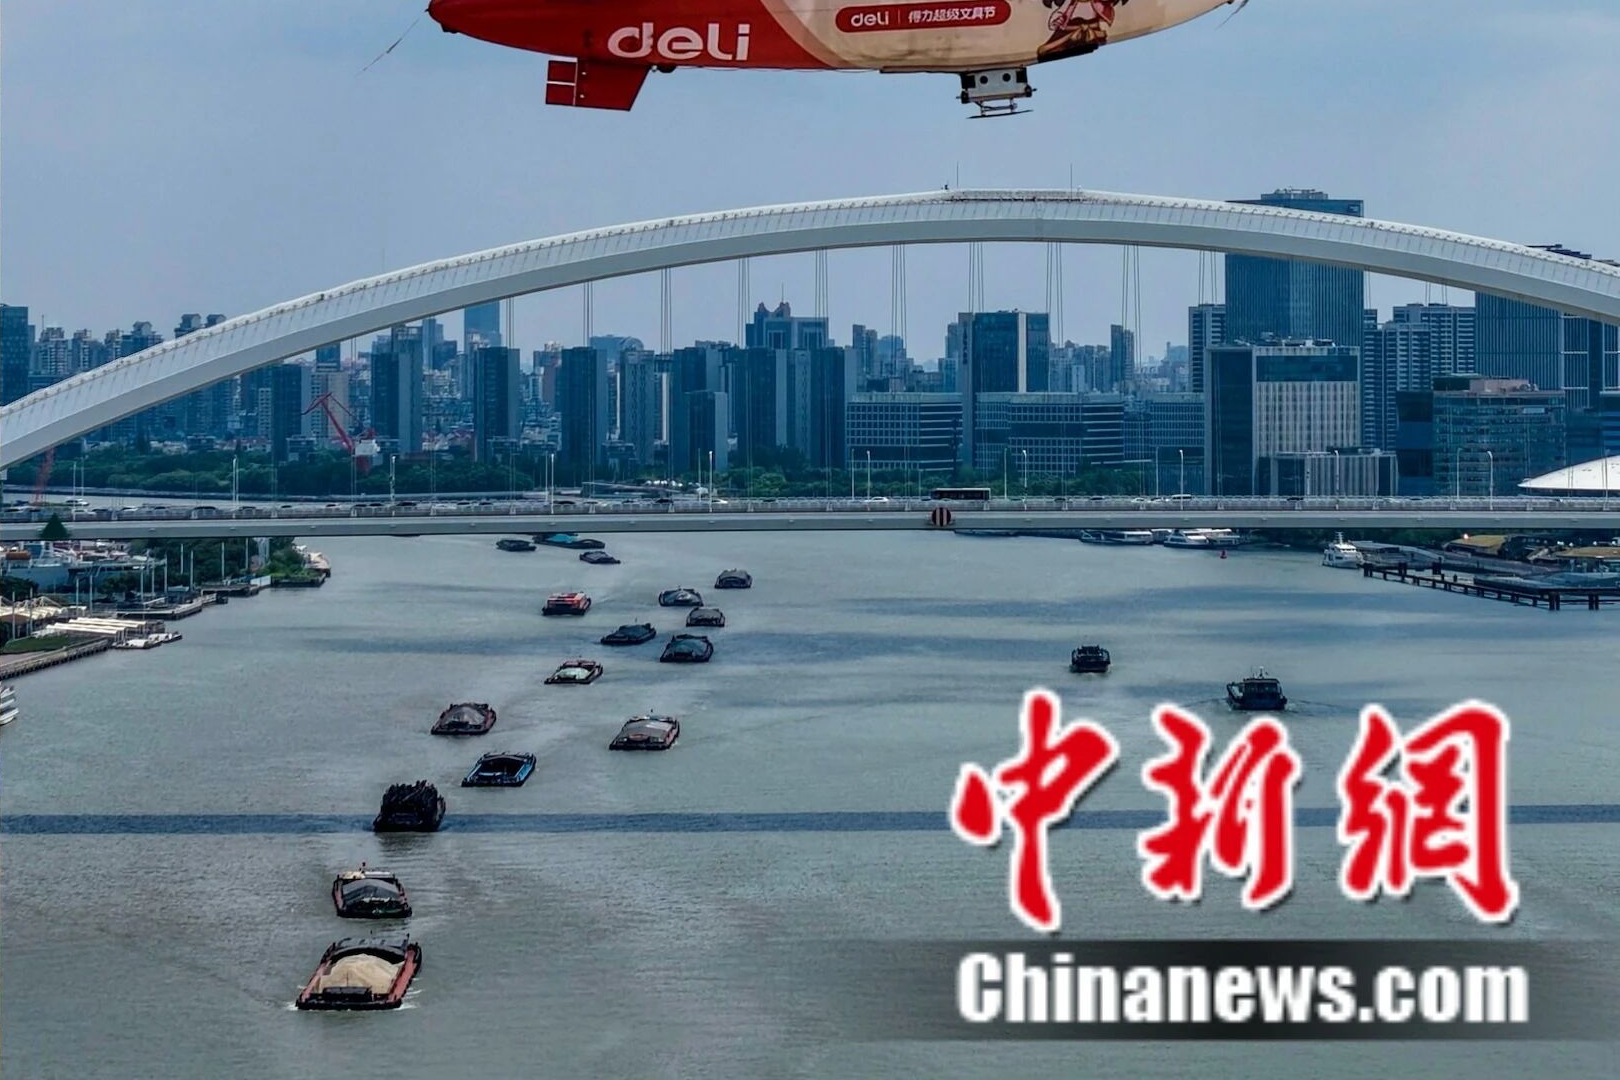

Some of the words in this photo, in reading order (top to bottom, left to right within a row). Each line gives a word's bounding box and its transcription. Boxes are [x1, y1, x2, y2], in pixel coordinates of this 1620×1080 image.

[851, 11, 889, 27] deli
[908, 6, 996, 24] 得力超级文具节
[607, 22, 750, 60] deli
